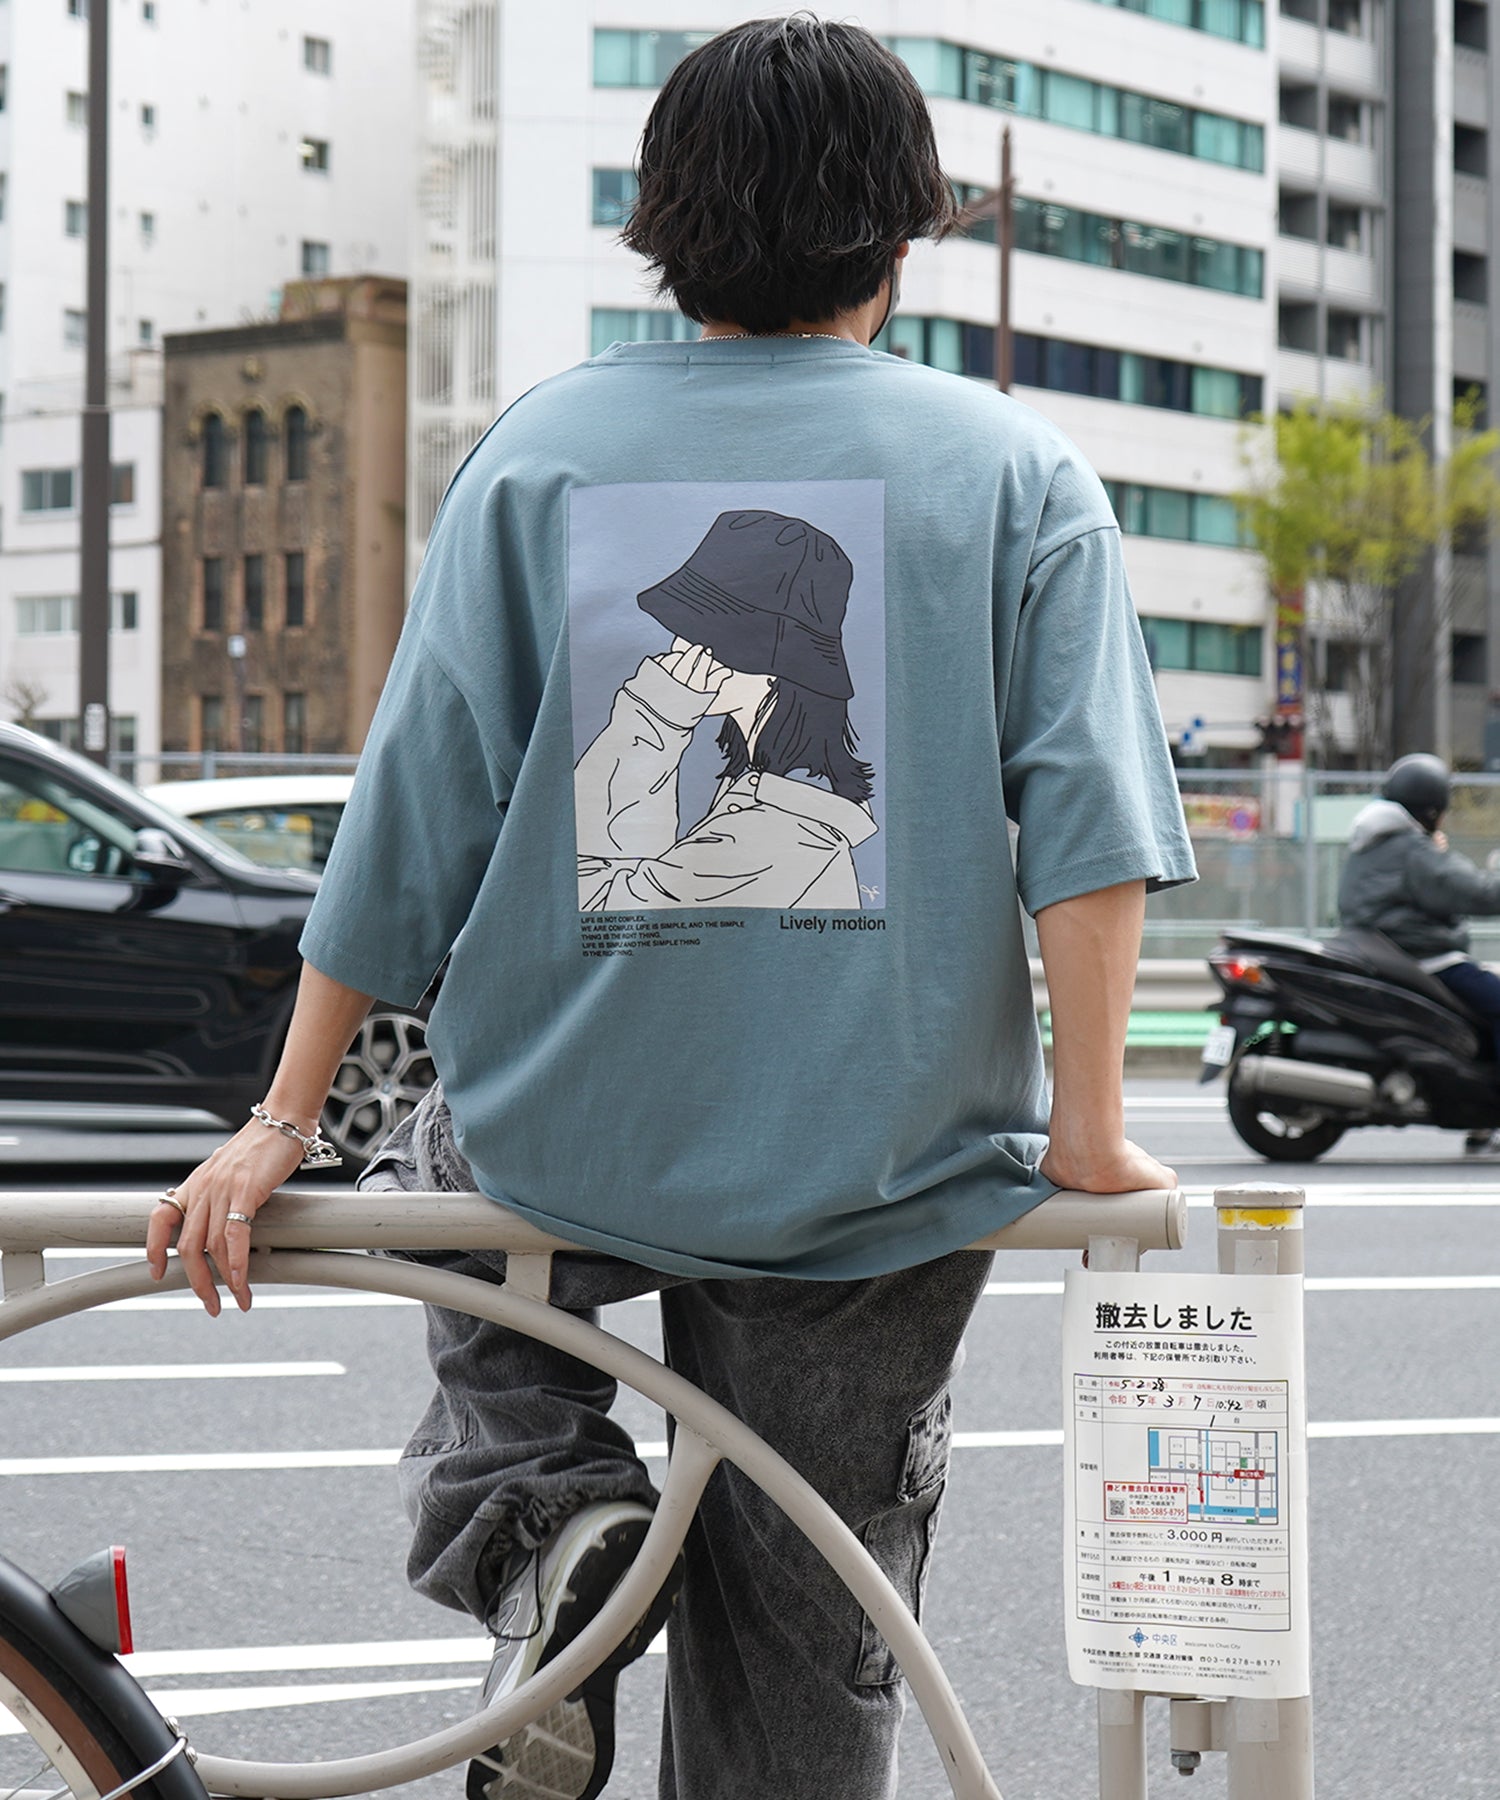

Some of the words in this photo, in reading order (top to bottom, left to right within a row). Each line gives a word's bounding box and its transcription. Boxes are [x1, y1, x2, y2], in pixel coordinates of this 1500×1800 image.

[720, 920, 744, 928] SIMPLE
[780, 915, 827, 934] Lively
[832, 915, 886, 931] motion
[1096, 1302, 1252, 1331] 撤去しました
[1152, 1633, 1177, 1646] 中央区
